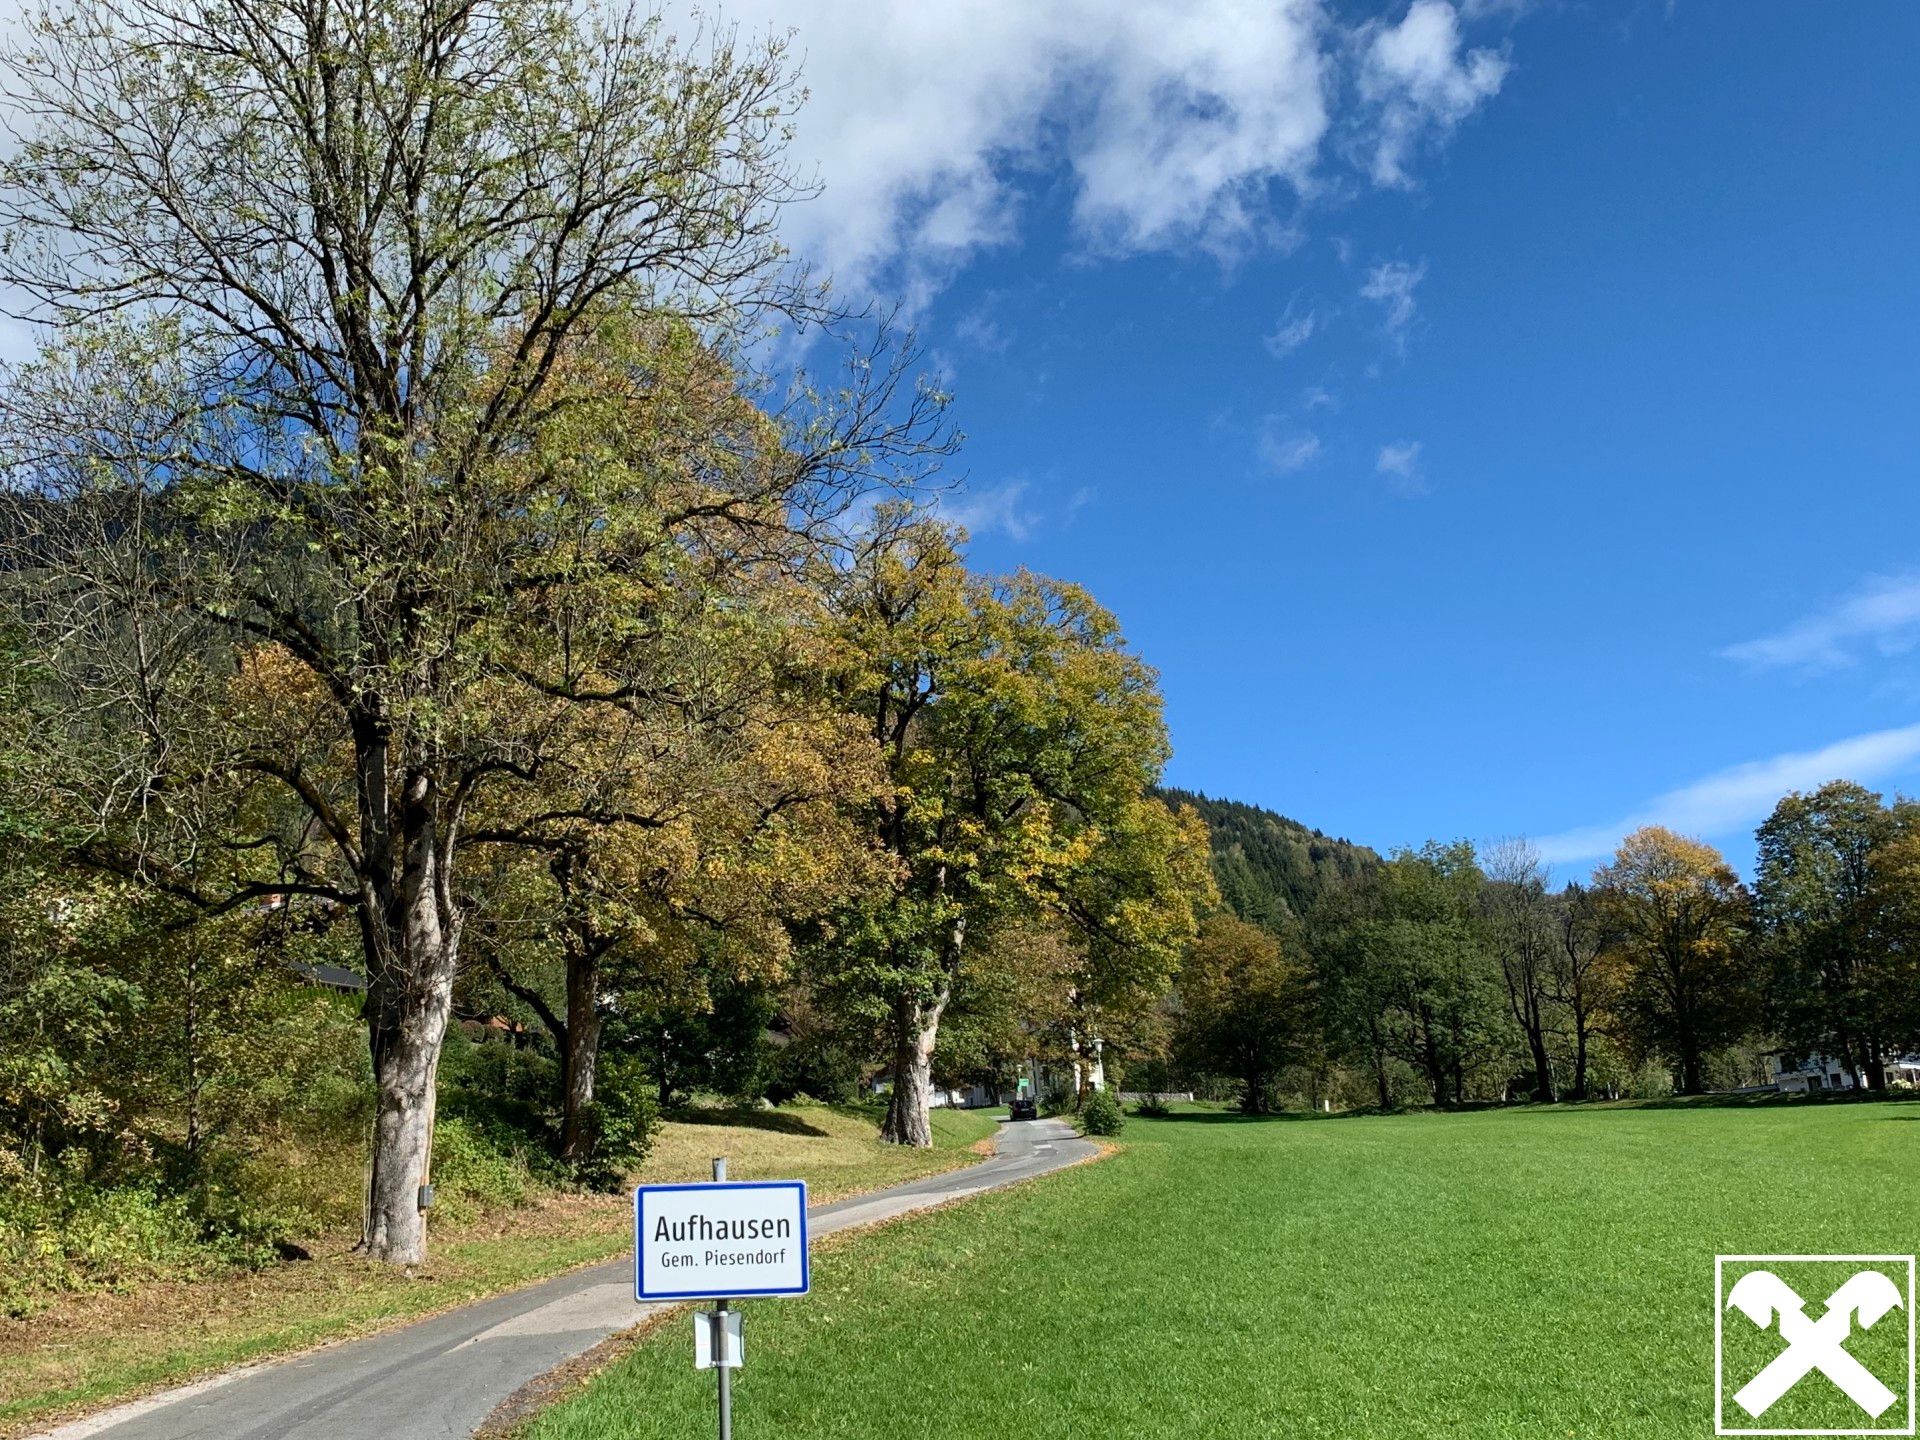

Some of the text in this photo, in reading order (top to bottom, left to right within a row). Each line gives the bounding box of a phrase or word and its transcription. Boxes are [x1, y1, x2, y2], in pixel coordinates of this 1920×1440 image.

[654, 1214, 790, 1242] Aufhausen
[661, 1248, 787, 1268] Gem. Piesendorf
